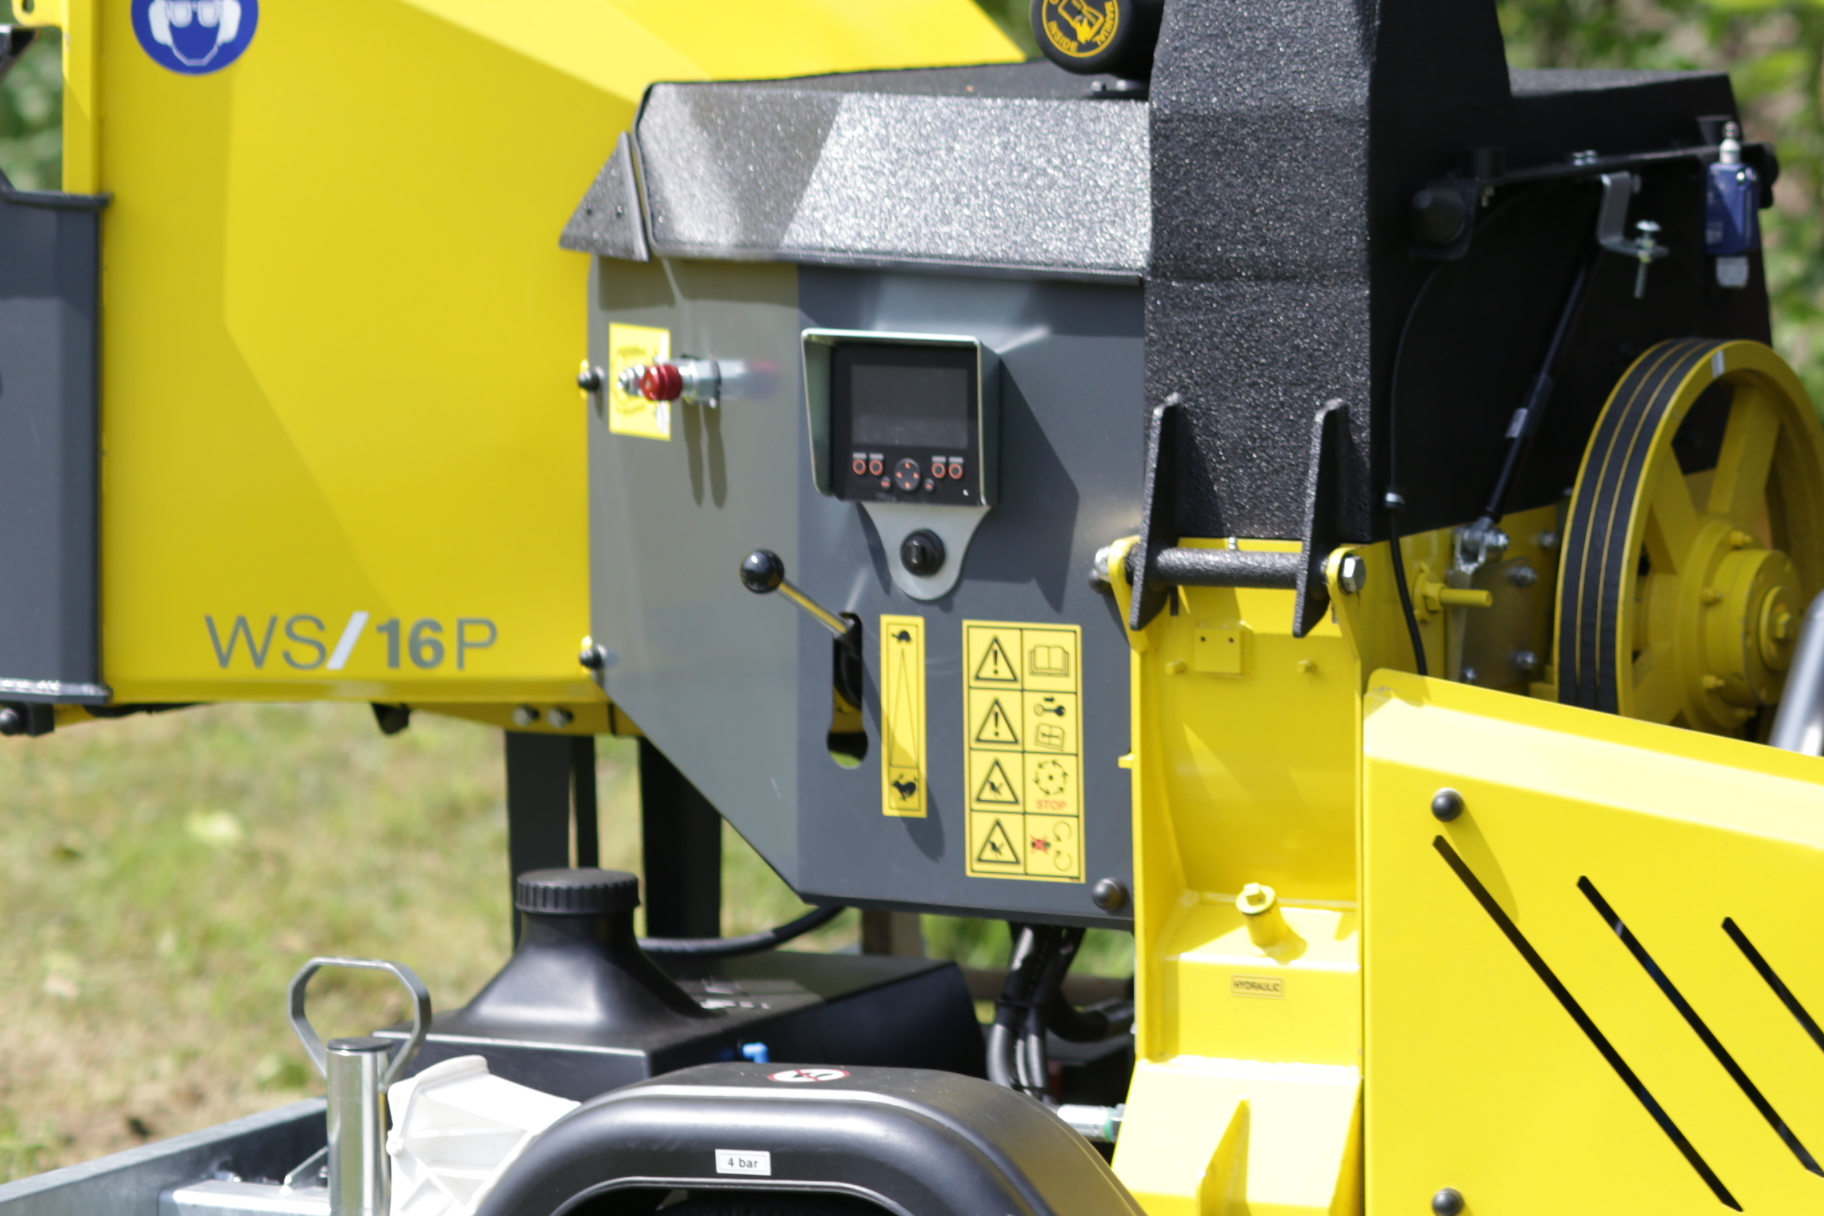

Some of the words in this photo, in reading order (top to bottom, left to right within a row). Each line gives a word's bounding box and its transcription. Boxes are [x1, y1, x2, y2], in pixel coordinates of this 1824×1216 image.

[1047, 20, 1079, 53] INSIDE
[1036, 798, 1067, 811] STOP
[727, 1157, 735, 1168] 4
[738, 1157, 759, 1169] bar
